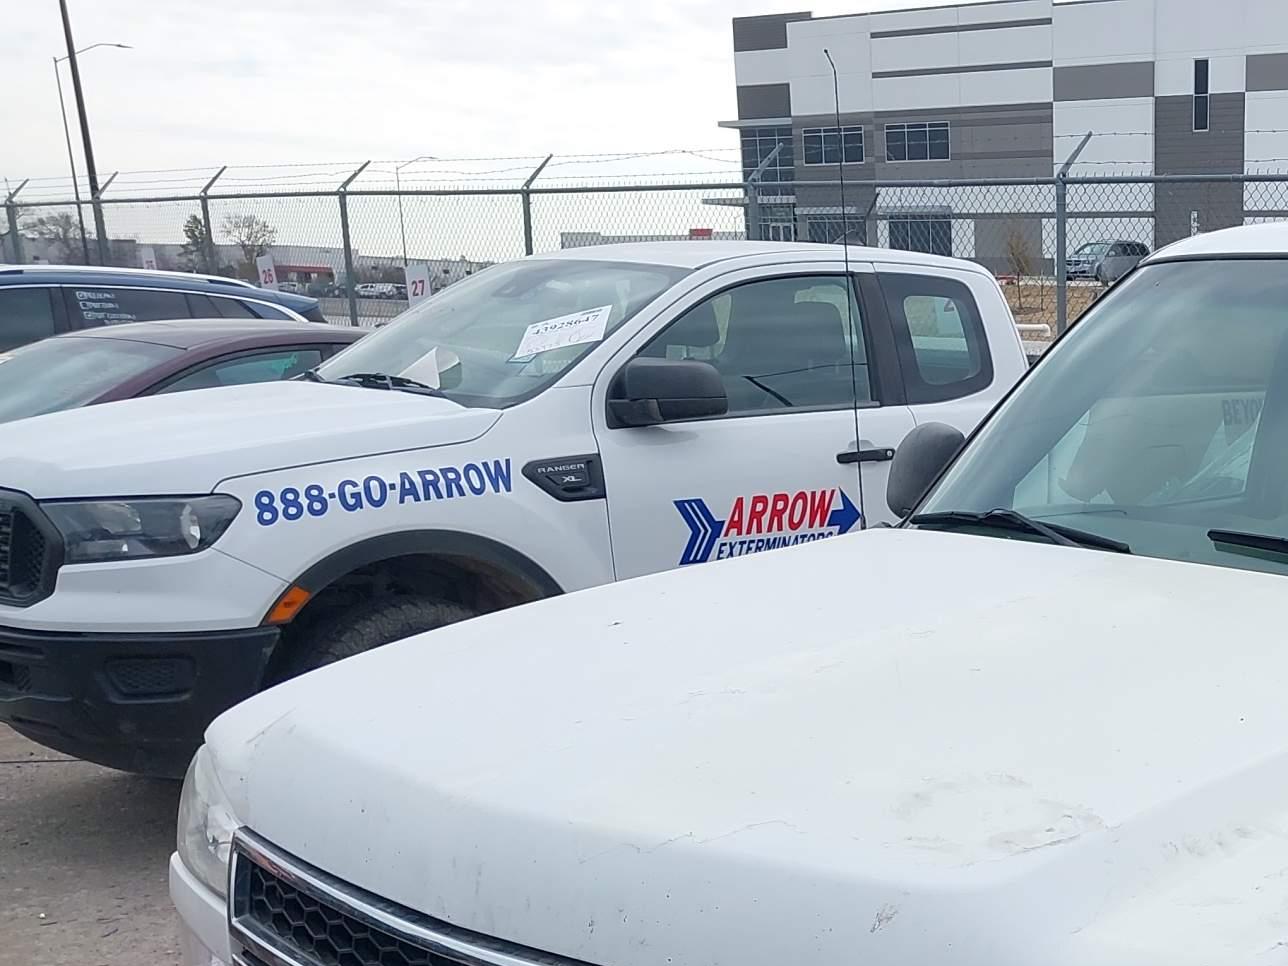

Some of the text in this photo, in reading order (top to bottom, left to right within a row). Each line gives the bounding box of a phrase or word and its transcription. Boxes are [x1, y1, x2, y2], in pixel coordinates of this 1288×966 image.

[411, 279, 425, 297] 27
[537, 463, 585, 474] RANGER
[561, 475, 582, 483] XL
[723, 488, 836, 538] ARROW
